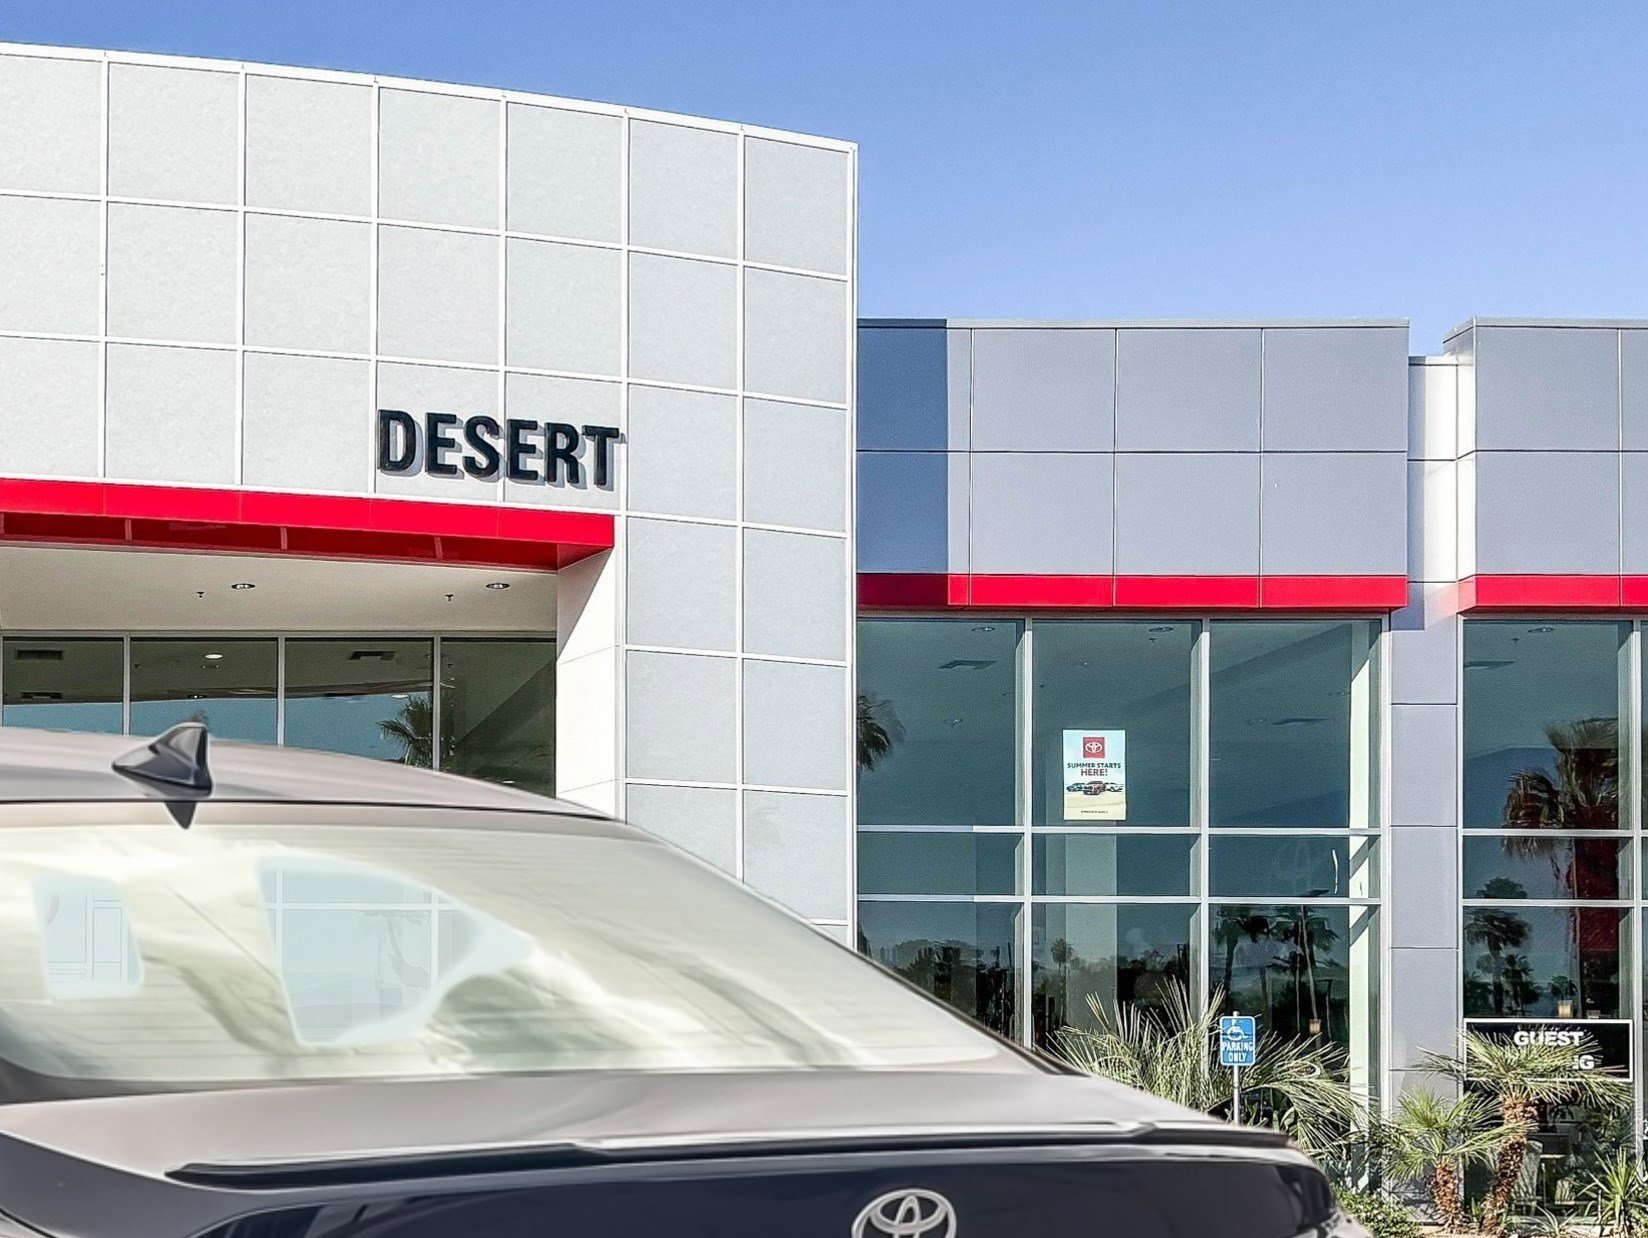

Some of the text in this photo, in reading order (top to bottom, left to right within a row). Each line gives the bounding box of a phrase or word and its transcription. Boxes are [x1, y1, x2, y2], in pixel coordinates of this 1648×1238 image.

[377, 409, 620, 486] DESERT
[1080, 768, 1108, 777] HERE!
[1513, 1030, 1585, 1047] GUEST
[1222, 1041, 1254, 1051] PARKING
[1228, 1051, 1248, 1063] ONLY
